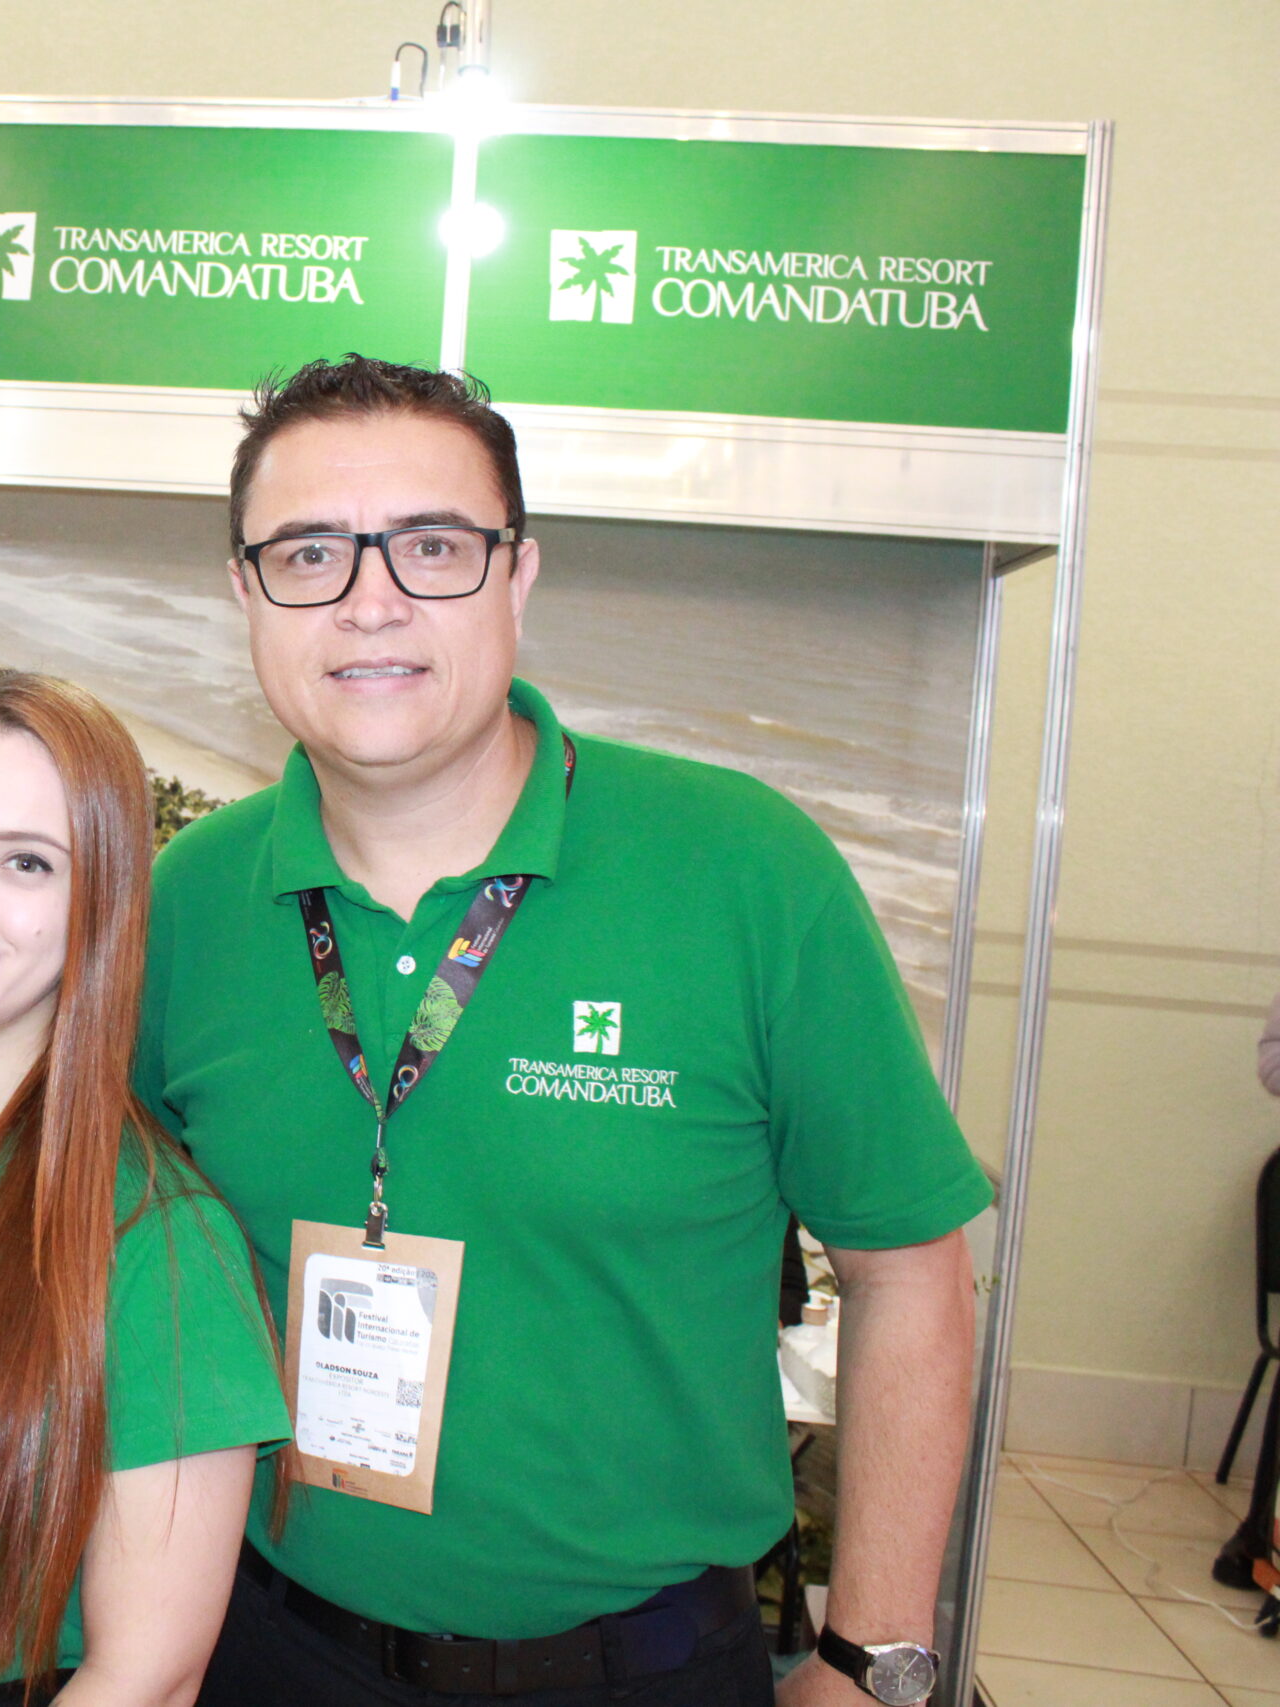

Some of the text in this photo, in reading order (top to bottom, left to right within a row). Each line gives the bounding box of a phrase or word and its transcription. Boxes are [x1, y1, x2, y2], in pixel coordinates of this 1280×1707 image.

[54, 226, 368, 261] TRANSAMERICA RESORT
[49, 257, 365, 305] COMANDATUBA
[655, 246, 992, 286] TRANSAMERICA RESORT
[652, 278, 989, 331] COMANDATUBA
[509, 1058, 679, 1086] TRANSAMERICA RESORT
[506, 1074, 677, 1108] COMANDATUBA
[357, 1321, 408, 1336] Internacional
[359, 1311, 388, 1323] Festival
[357, 1330, 387, 1343] Turismo
[352, 1369, 379, 1380] SOUZA
